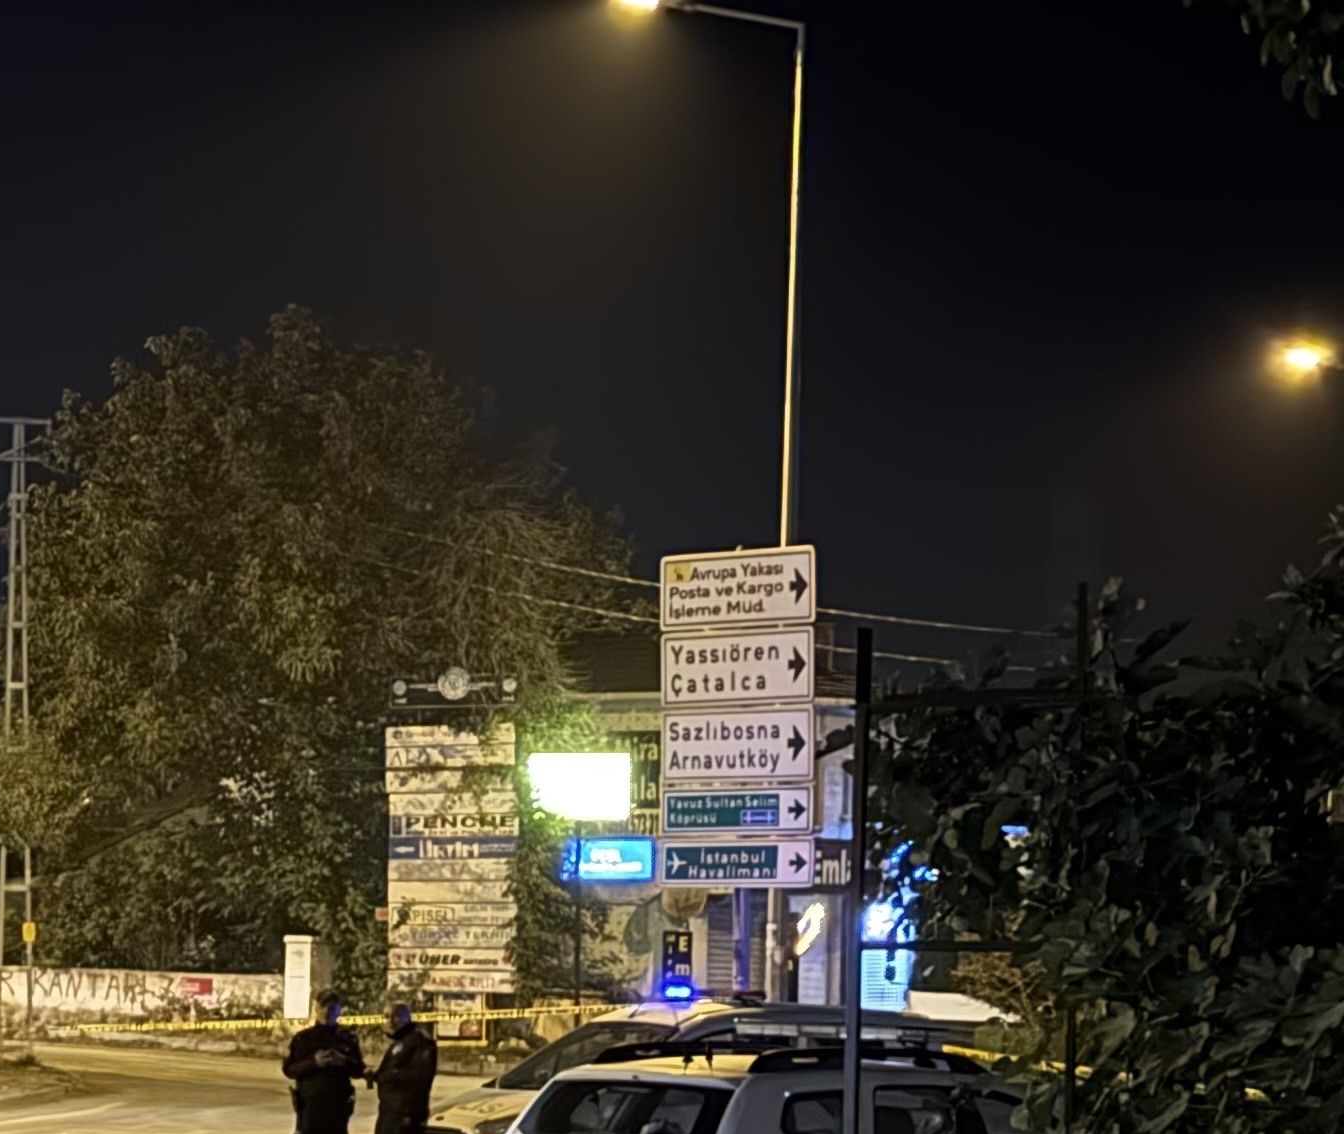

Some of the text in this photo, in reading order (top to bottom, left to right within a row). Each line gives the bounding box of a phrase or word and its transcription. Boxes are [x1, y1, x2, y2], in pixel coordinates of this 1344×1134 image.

[691, 562, 784, 582] Avrupa Yakası
[669, 581, 784, 600] Posta ve Kargo
[668, 602, 722, 619] İşleme
[670, 643, 780, 665] Yassıören
[670, 671, 767, 697] Çatalca
[668, 720, 781, 741] Sazlıbosna
[668, 748, 781, 773] Arnavutköy
[670, 795, 778, 809] Yavuz Sultan Selim
[669, 813, 717, 825] Köprüsü
[700, 847, 766, 864] İstanbul
[688, 866, 777, 878] Havalimanı
